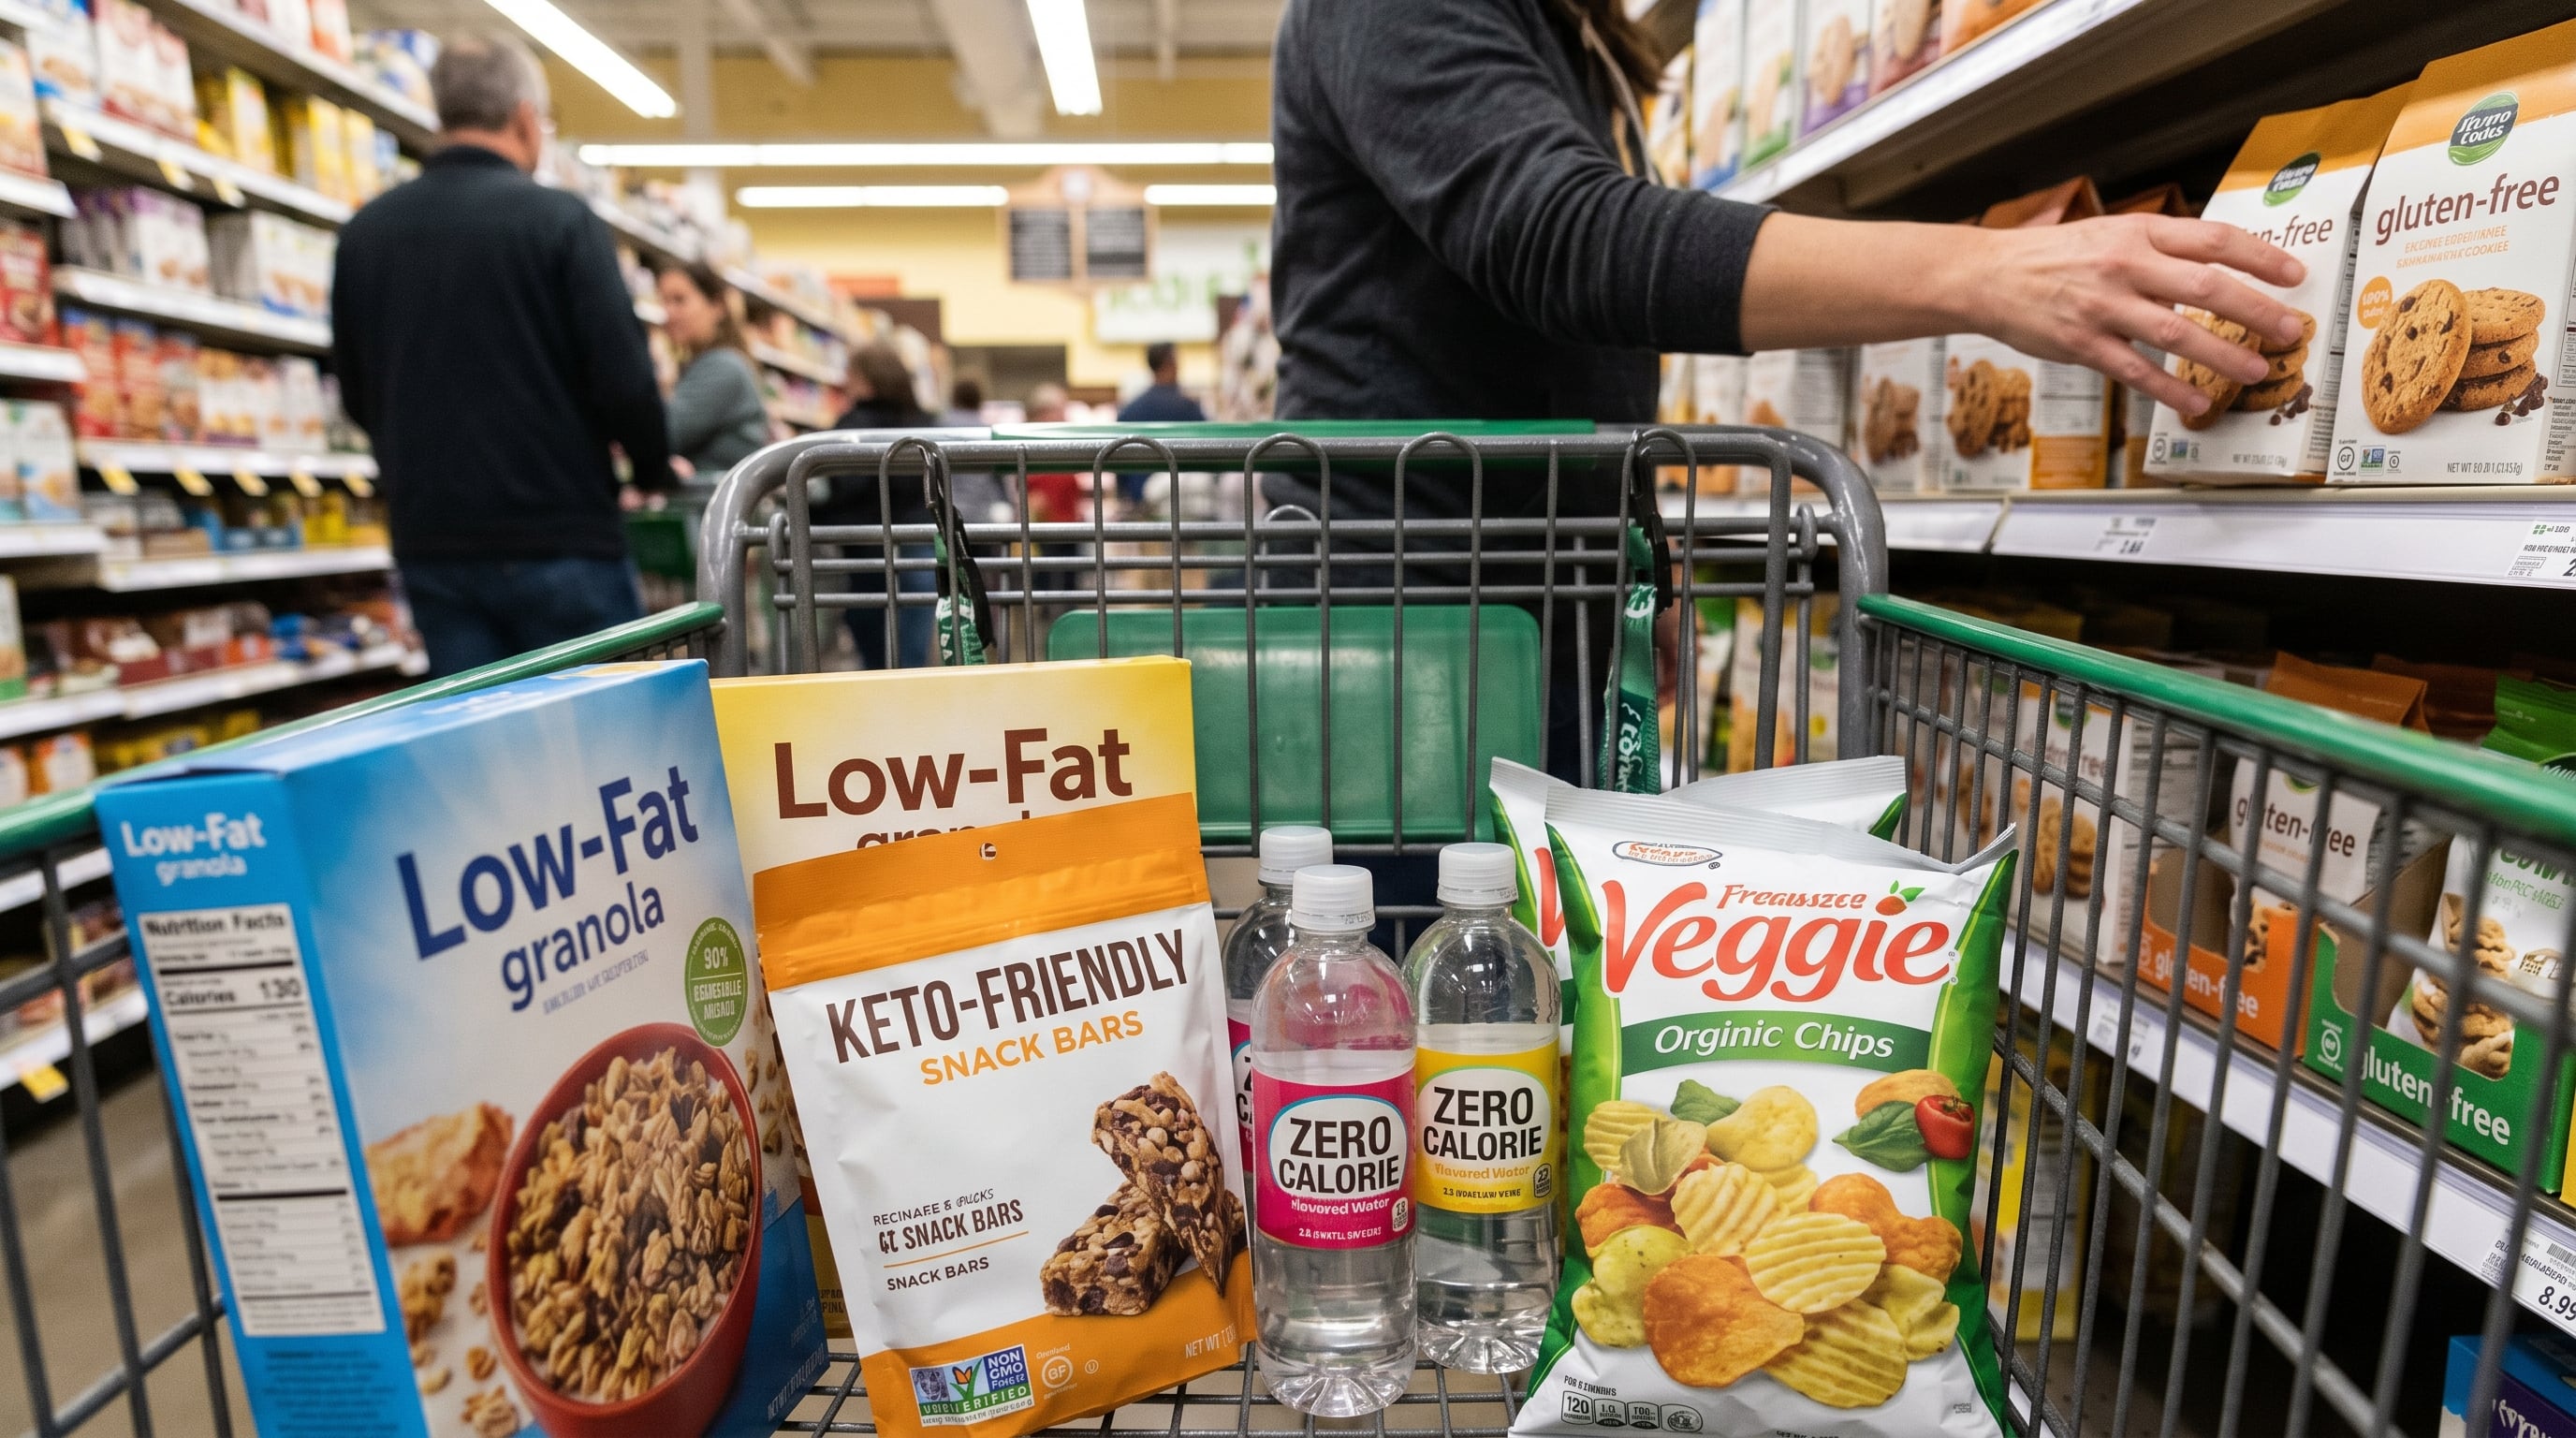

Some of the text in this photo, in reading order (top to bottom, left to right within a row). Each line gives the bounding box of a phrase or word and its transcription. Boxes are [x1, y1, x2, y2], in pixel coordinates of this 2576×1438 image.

[2376, 173, 2560, 246] gluten-free
[774, 727, 1133, 820] Low-Fat
[121, 812, 267, 858] Low-Fat
[156, 853, 247, 887] granola
[396, 765, 699, 961] Low-Fat
[501, 881, 666, 1012] granola
[1602, 879, 1951, 1003] Veggie
[826, 929, 1188, 1064] KETO-FRIENDLY
[920, 1010, 1145, 1086] SNACK BARS
[1654, 1020, 1895, 1060] Orginic Chips
[1433, 1086, 1533, 1127] ZERO
[1290, 1115, 1392, 1160] ZERO
[1423, 1125, 1542, 1162] CALORIE
[1279, 1154, 1400, 1195] CALORIE
[902, 1212, 969, 1250] SNACK
[971, 1198, 1024, 1234] BARS
[886, 1256, 989, 1291] SNACK BARS
[988, 1350, 1020, 1370] NON
[1185, 1339, 1204, 1359] NET
[1205, 1333, 1220, 1352] WT
[1567, 1395, 1589, 1415] 120
